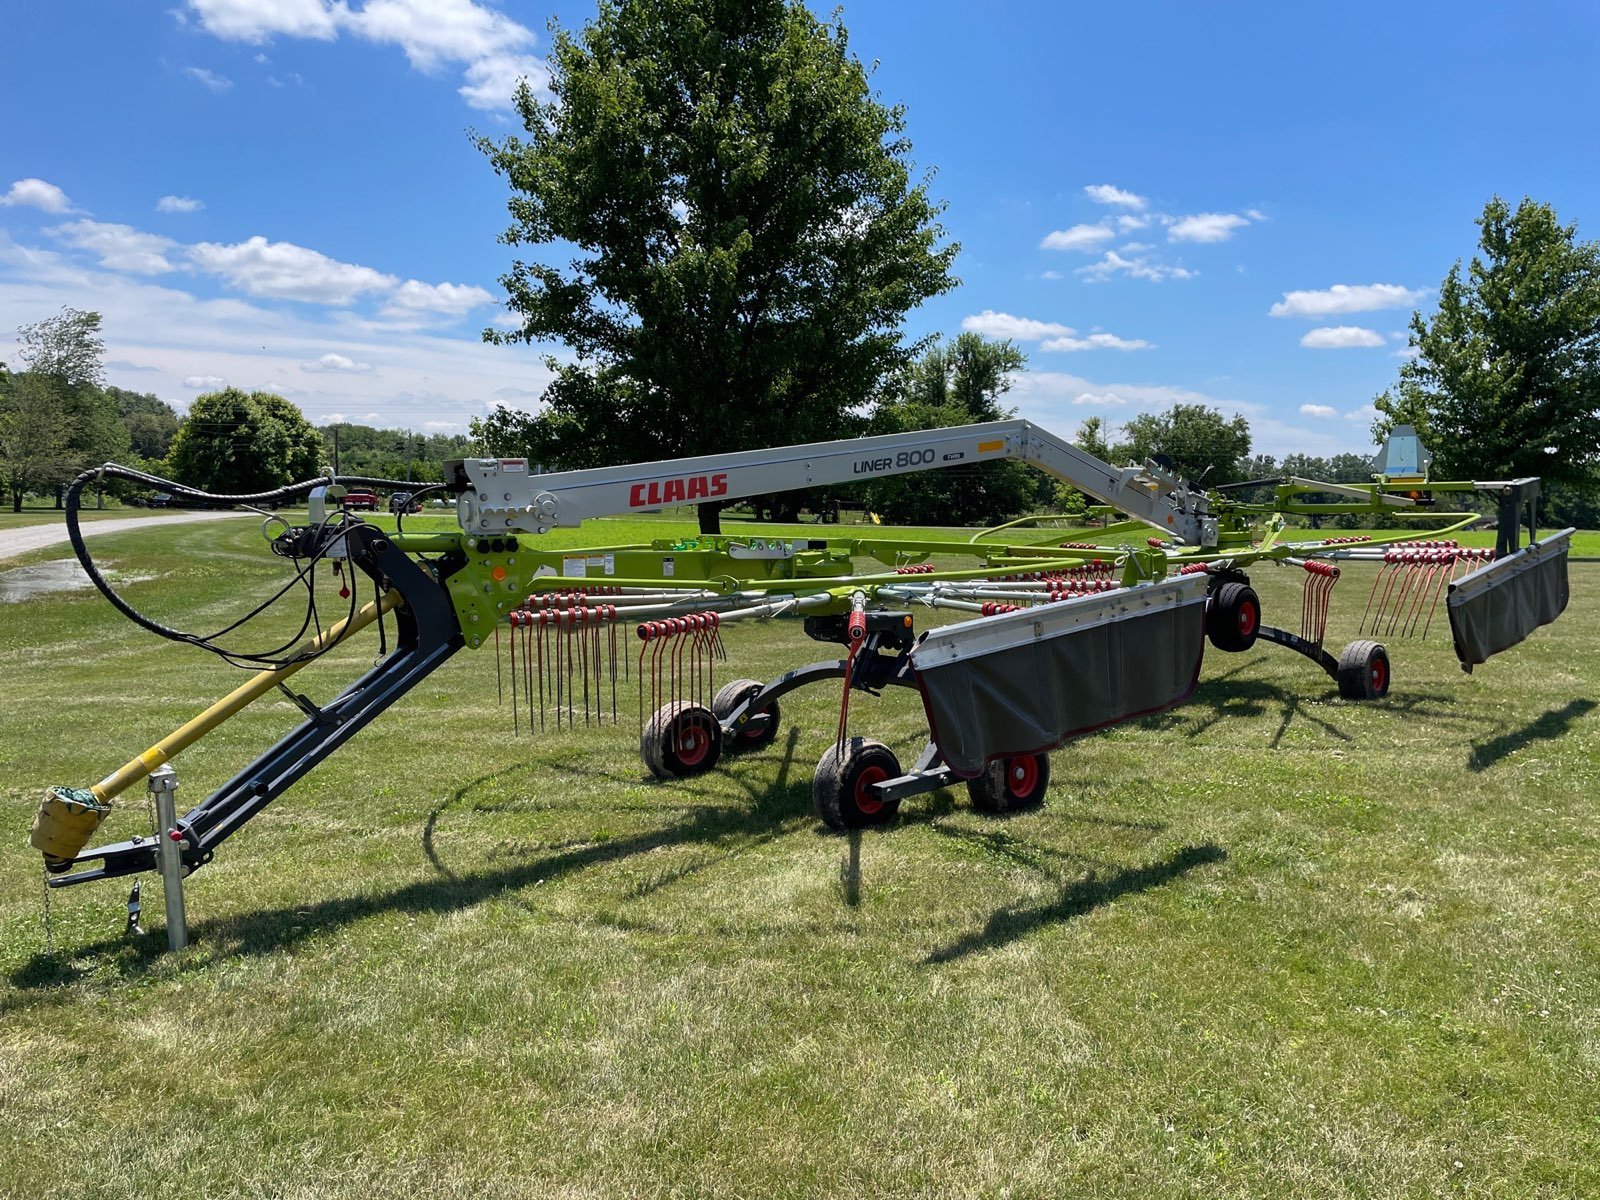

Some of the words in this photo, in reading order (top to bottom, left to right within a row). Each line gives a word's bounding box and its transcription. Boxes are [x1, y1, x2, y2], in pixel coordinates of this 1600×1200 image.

[853, 457, 892, 474] LINER
[896, 448, 935, 468] 800
[629, 473, 728, 507] CLAAS
